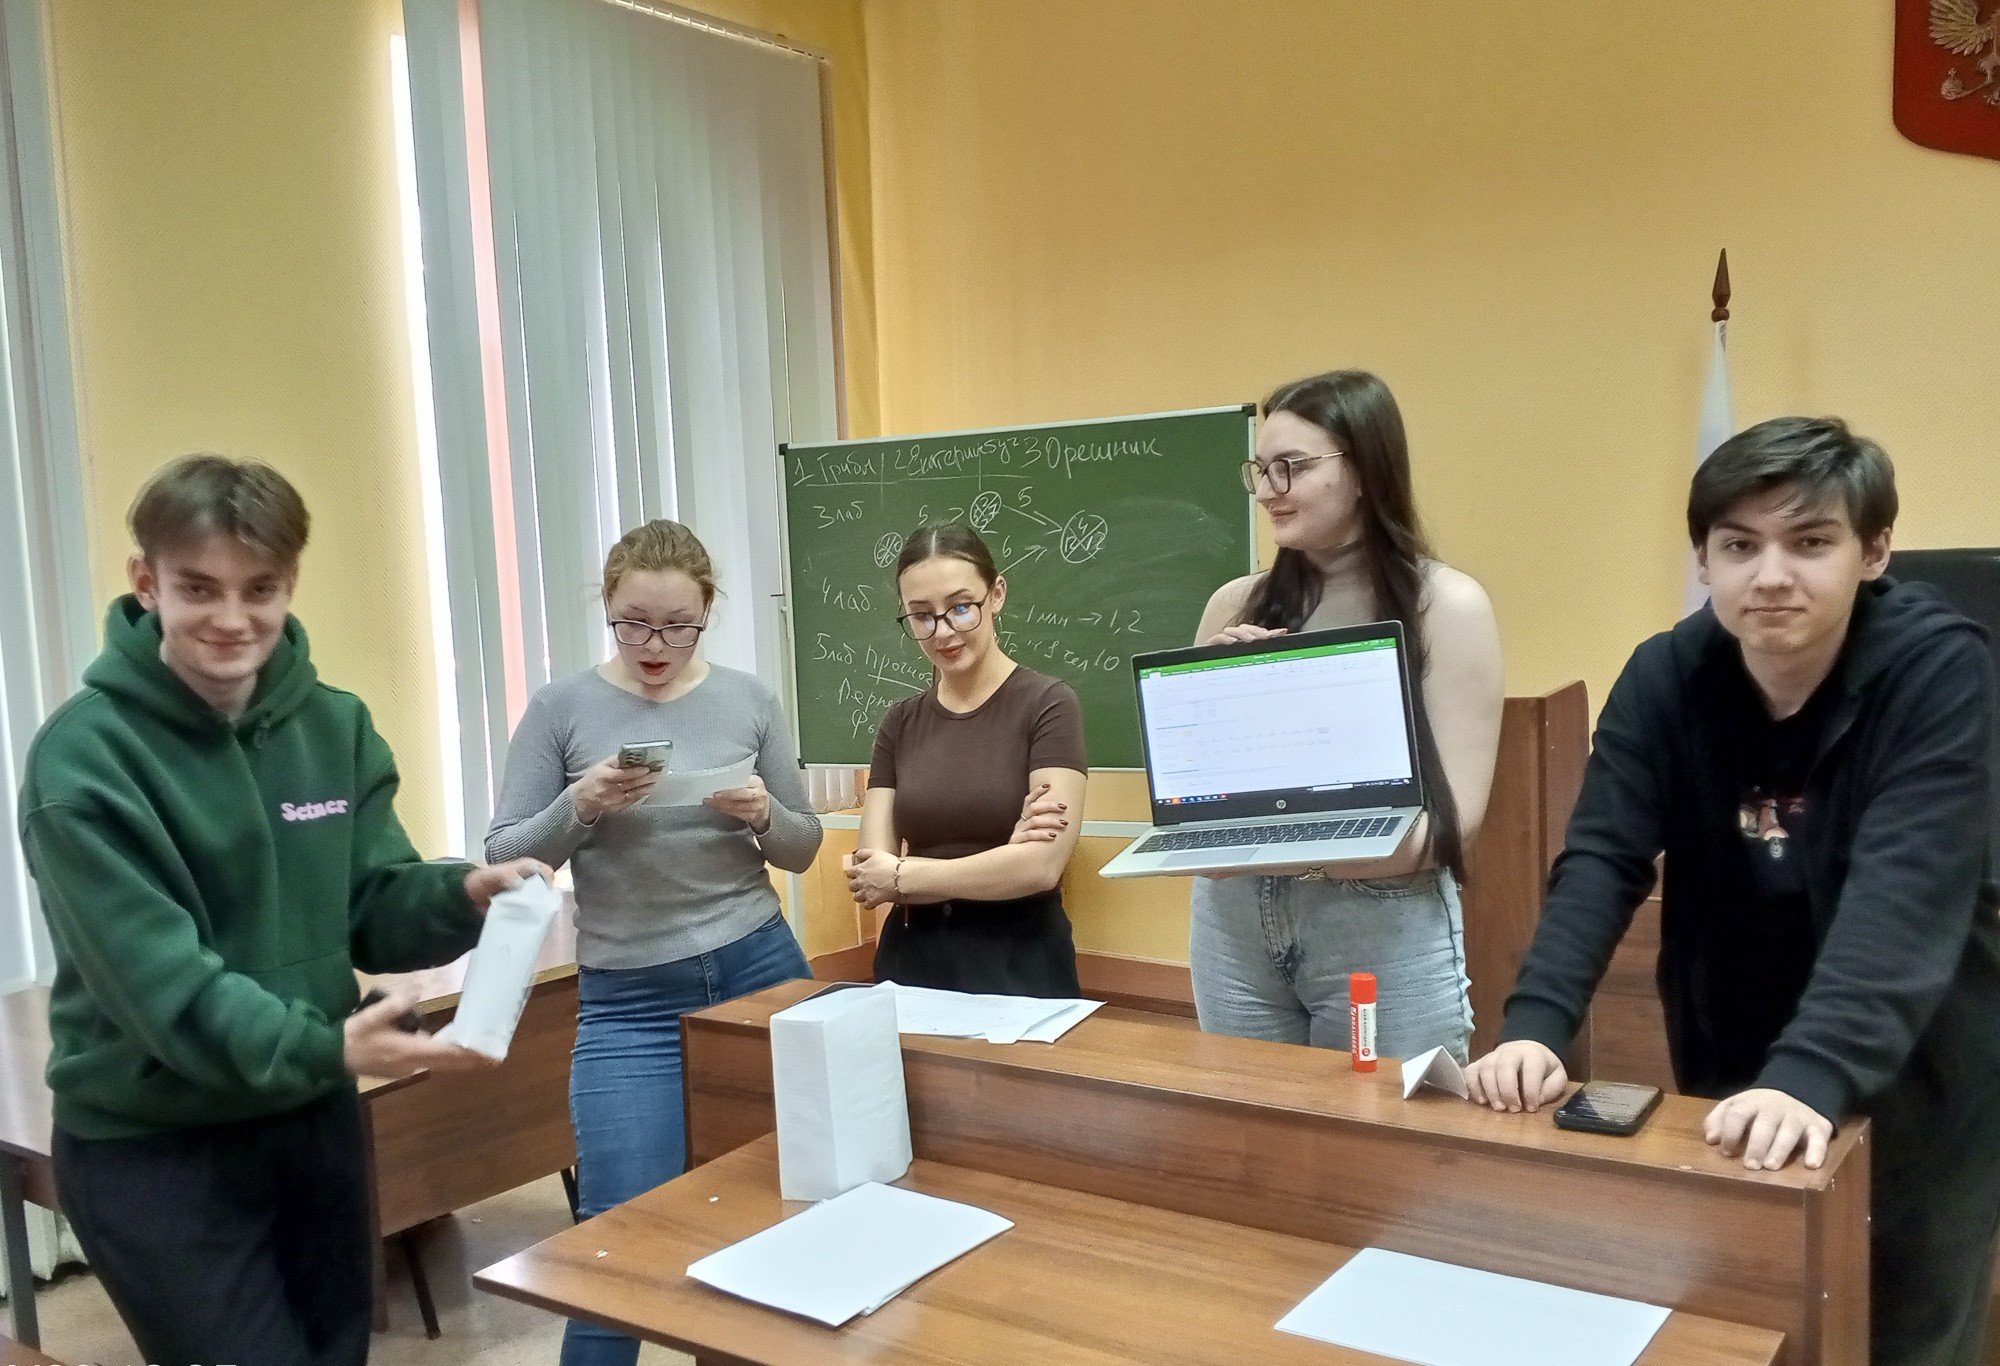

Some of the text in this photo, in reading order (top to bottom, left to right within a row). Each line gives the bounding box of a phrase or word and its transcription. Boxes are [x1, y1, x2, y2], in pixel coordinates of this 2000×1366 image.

[793, 458, 814, 486] 1
[1020, 437, 1164, 479] 3 Орешник
